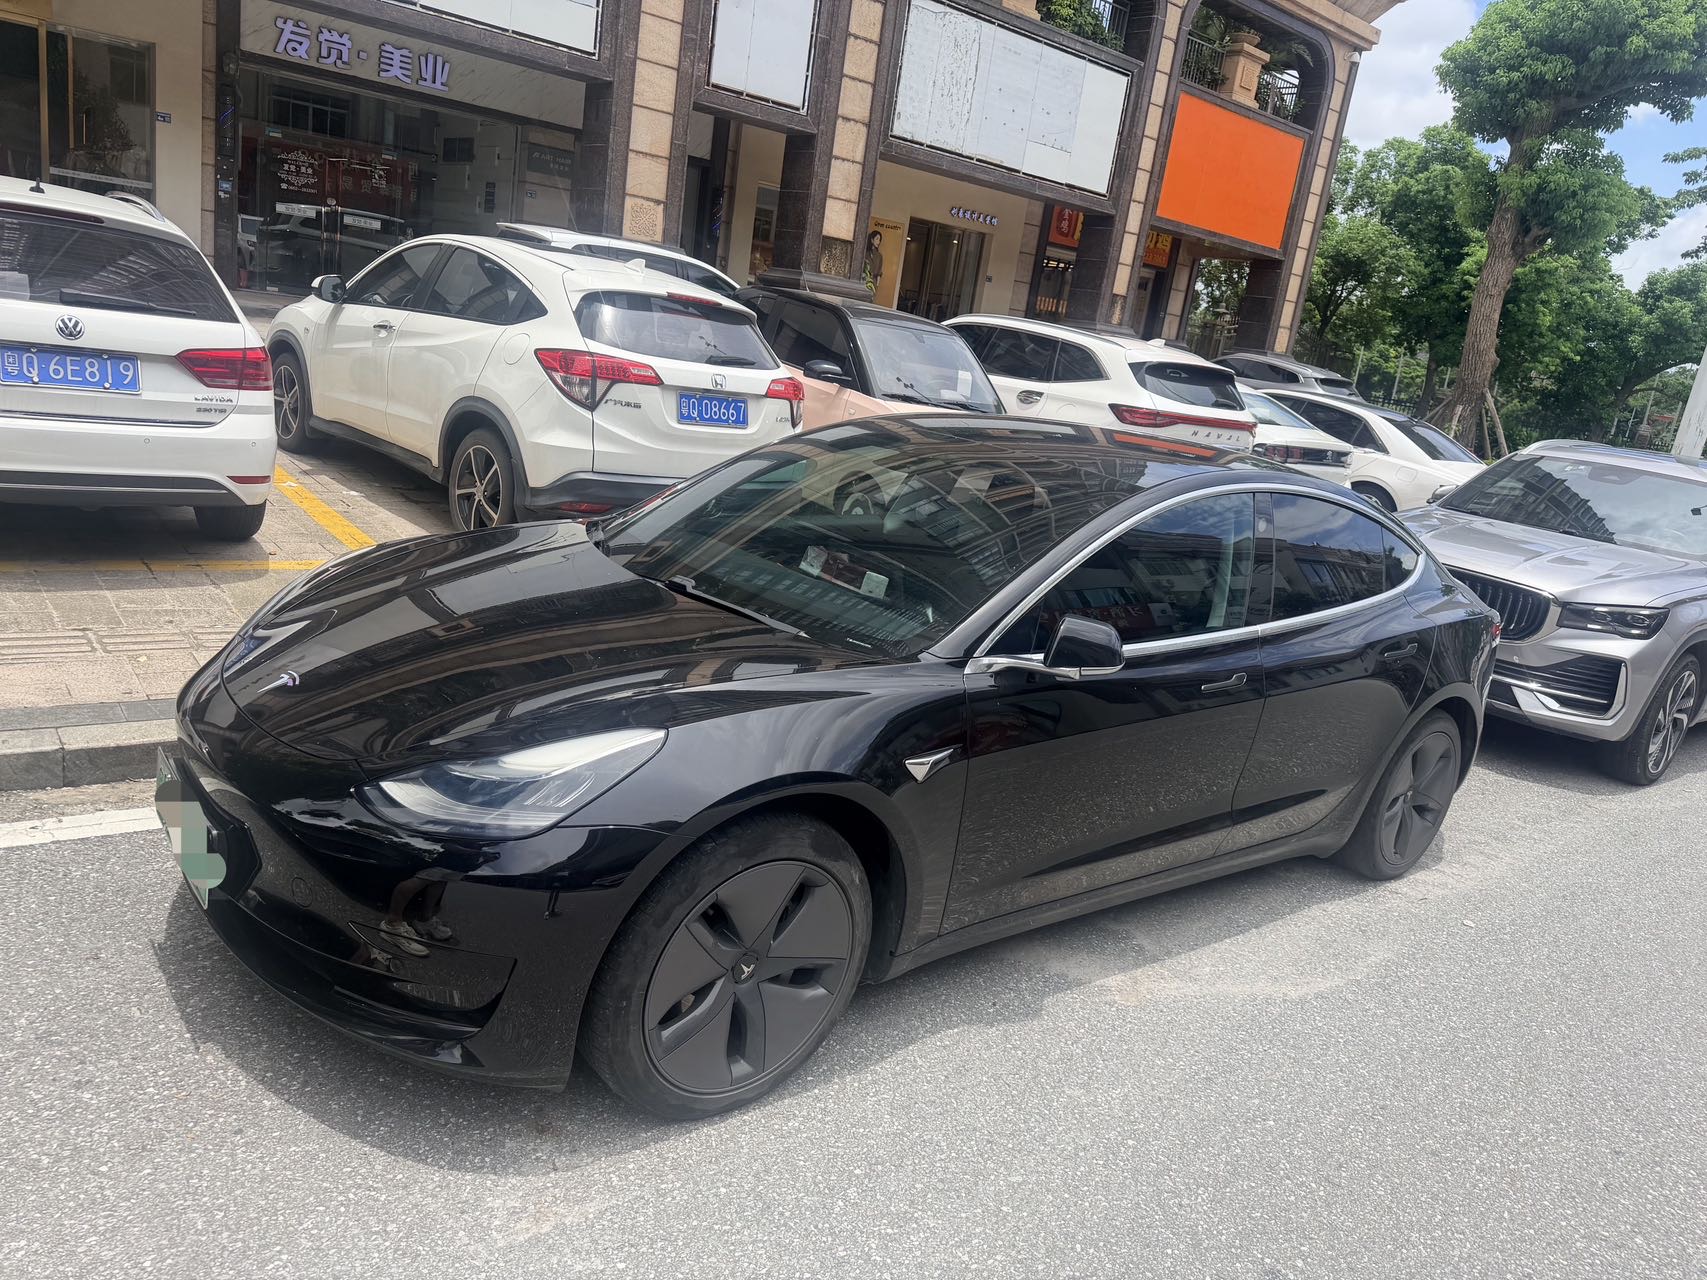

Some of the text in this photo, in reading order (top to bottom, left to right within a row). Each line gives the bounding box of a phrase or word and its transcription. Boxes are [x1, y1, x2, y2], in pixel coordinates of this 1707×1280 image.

[274, 16, 449, 92] 发觉·美业
[1191, 430, 1240, 442] HAVAL
